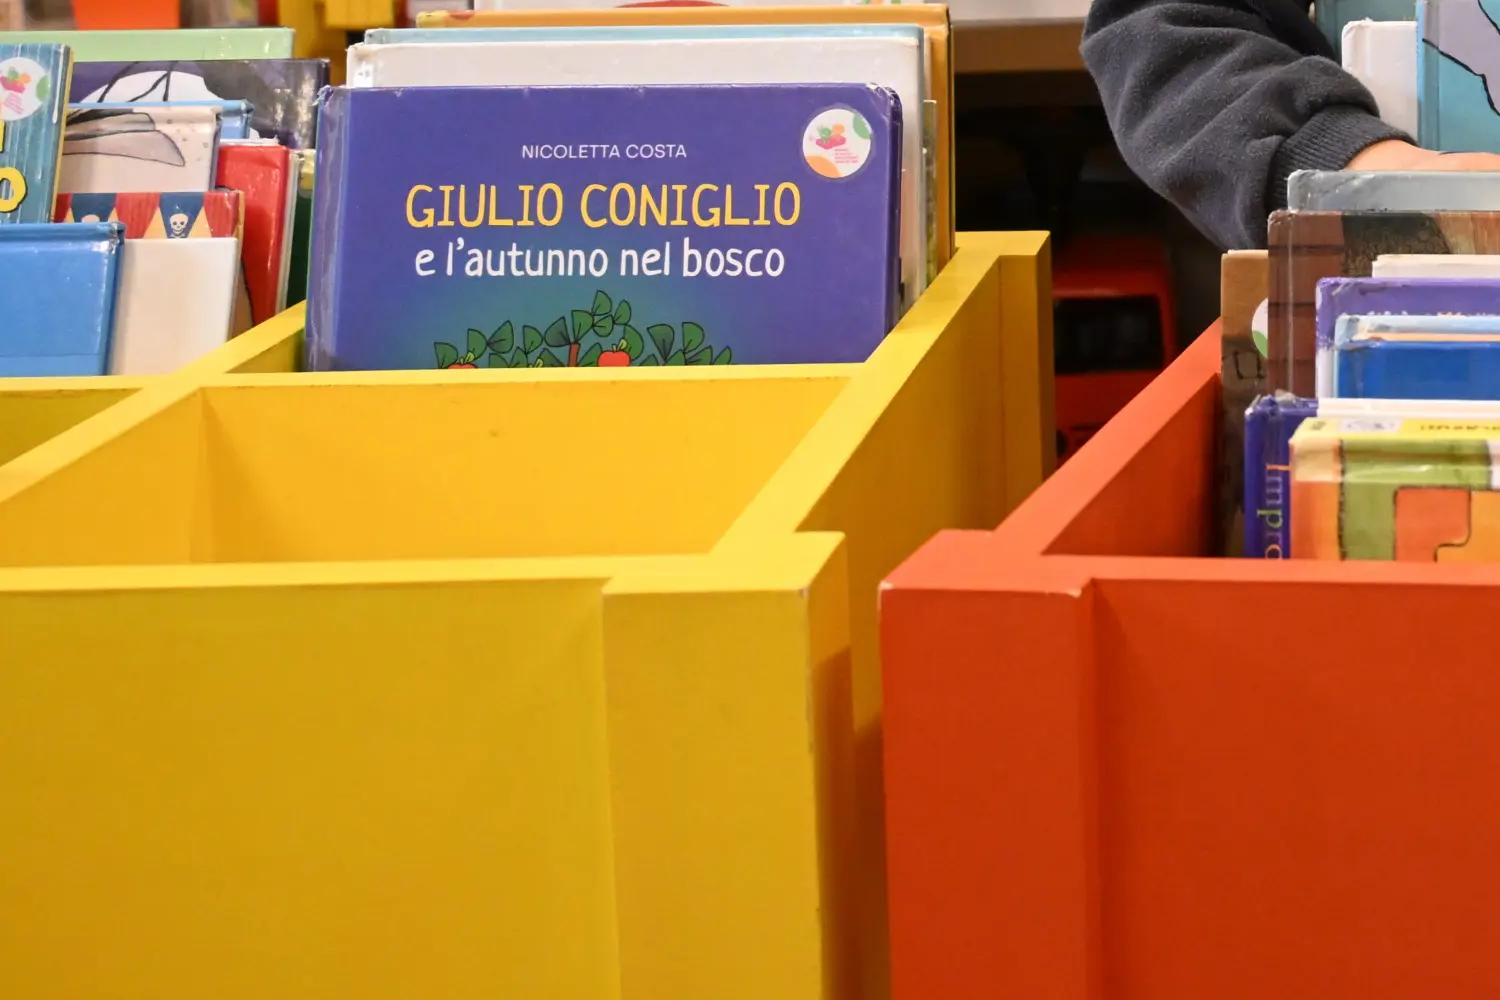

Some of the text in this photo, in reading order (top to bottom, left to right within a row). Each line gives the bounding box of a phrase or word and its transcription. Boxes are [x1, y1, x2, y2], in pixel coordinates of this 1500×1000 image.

[522, 143, 687, 159] NICOLETTA COSTA
[405, 181, 801, 228] GIULIO CONIGLIO
[415, 249, 436, 277] e
[620, 241, 670, 276] nel
[682, 236, 785, 277] bosco
